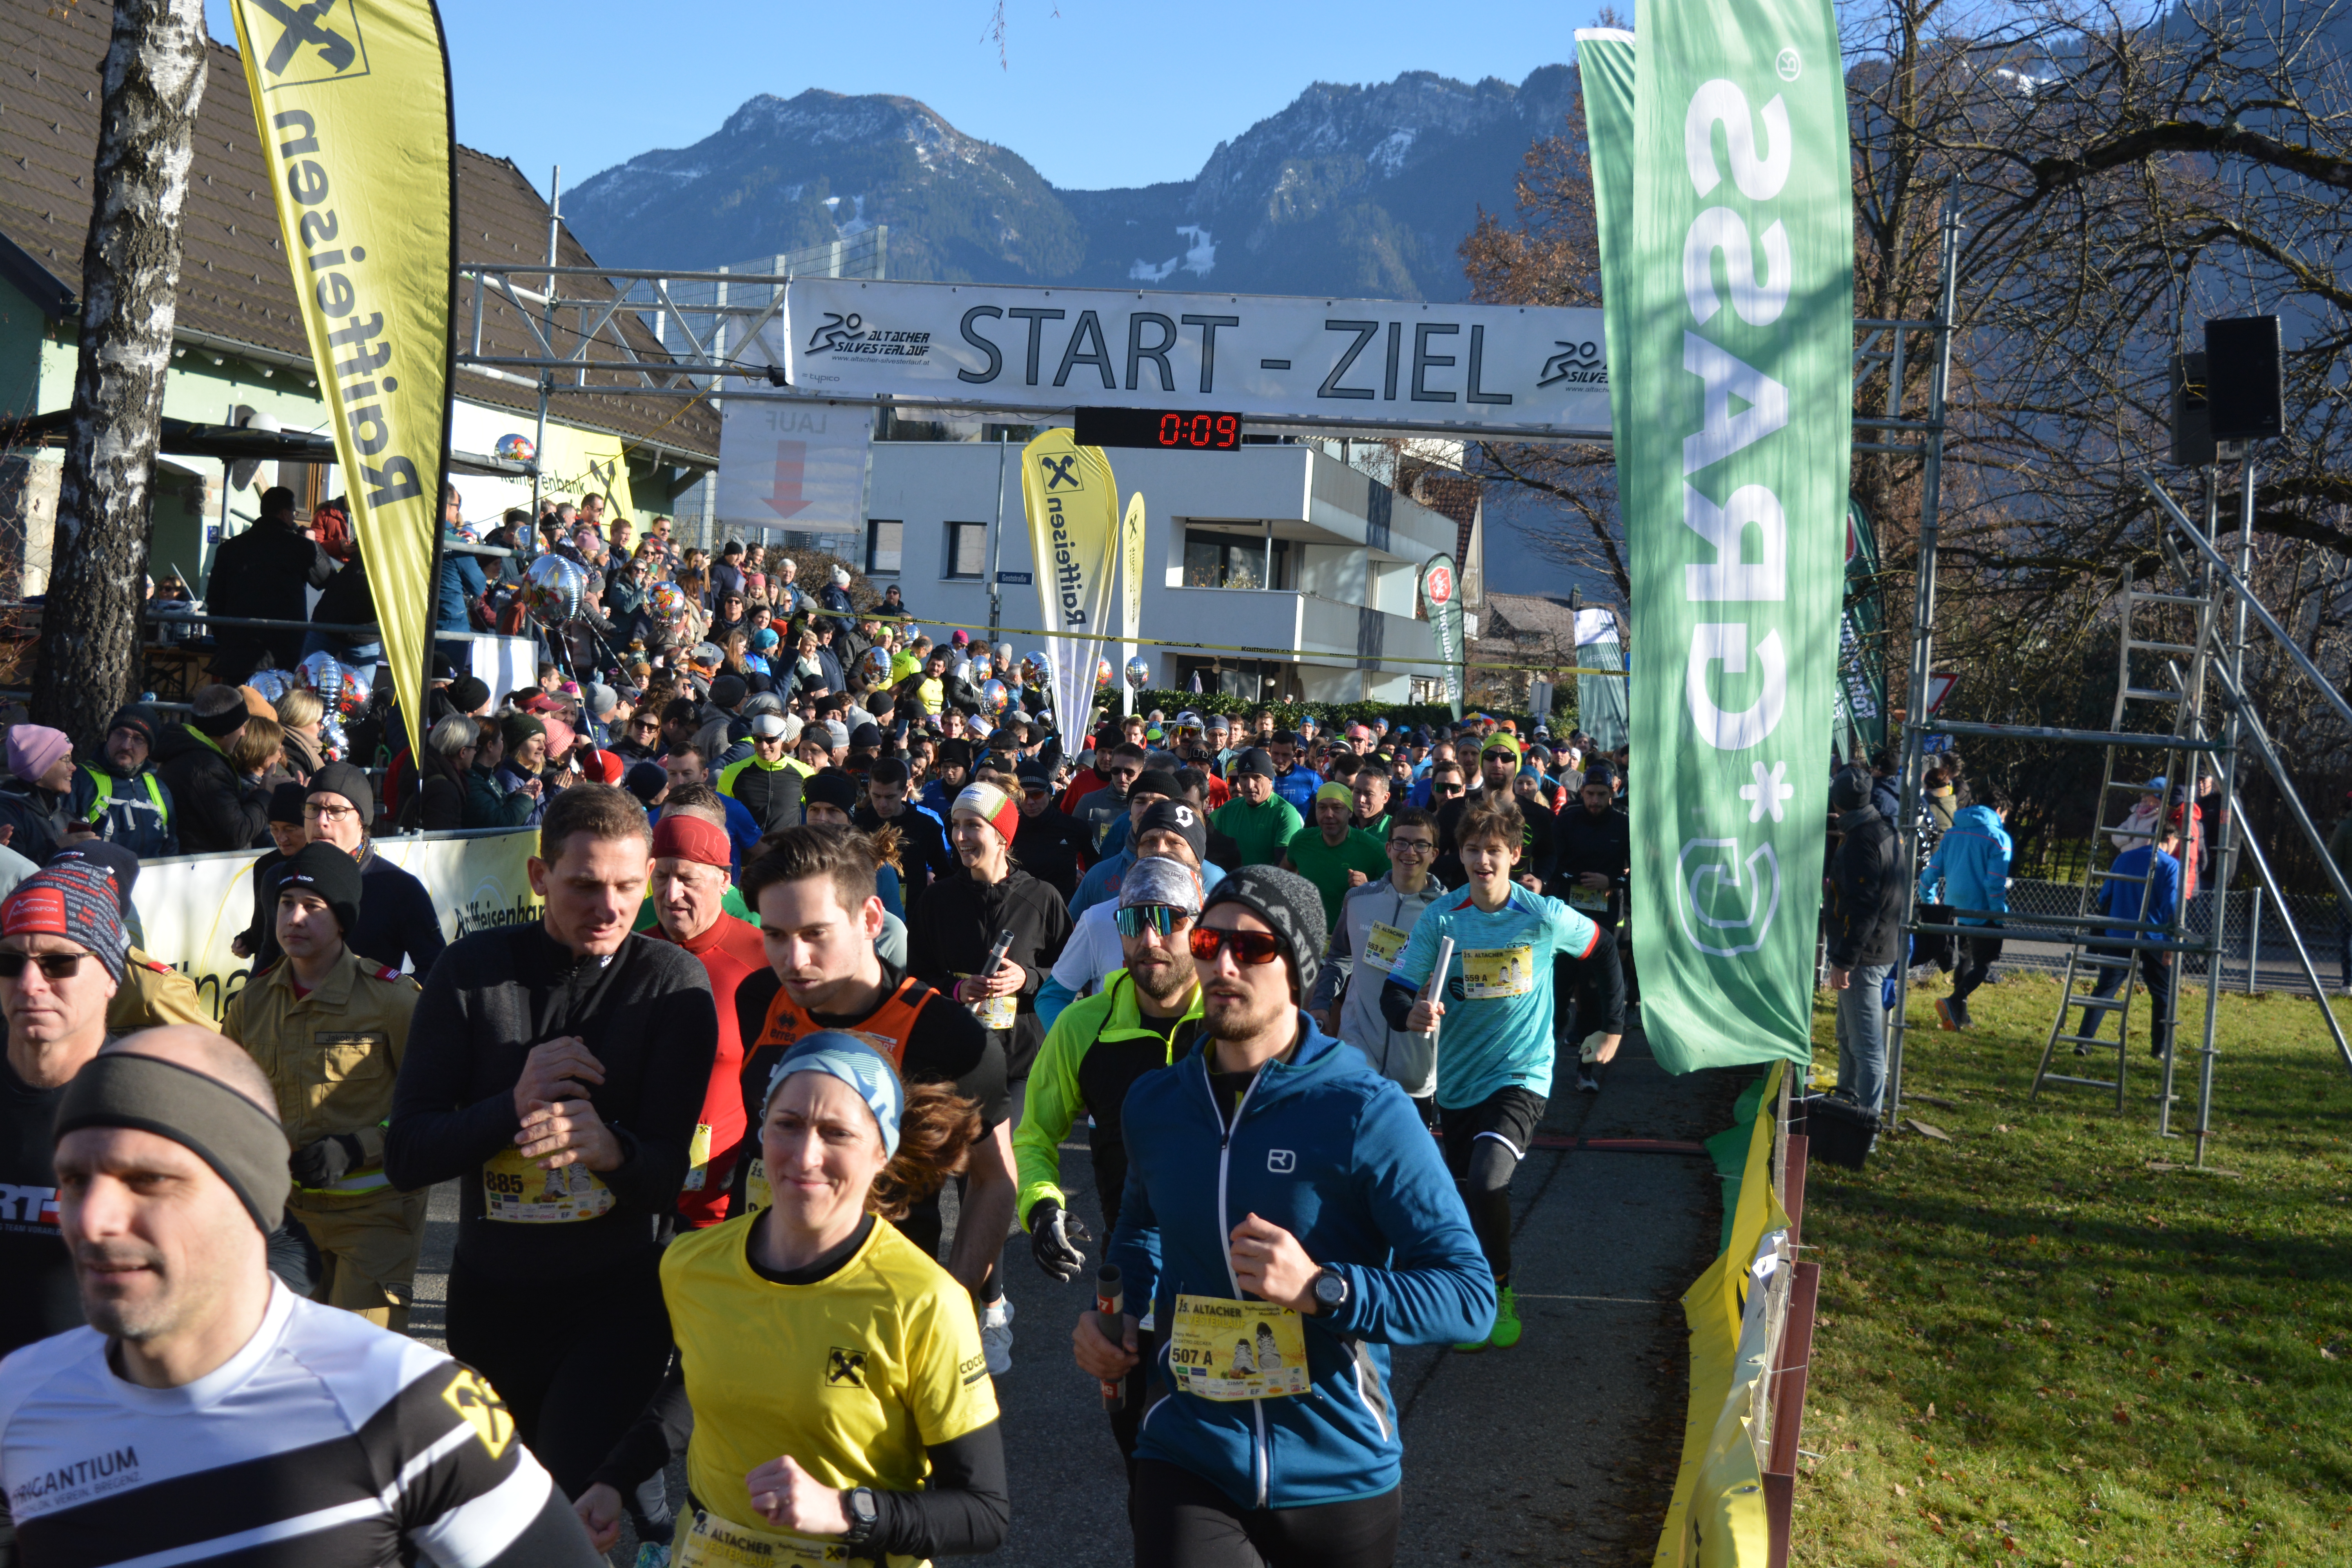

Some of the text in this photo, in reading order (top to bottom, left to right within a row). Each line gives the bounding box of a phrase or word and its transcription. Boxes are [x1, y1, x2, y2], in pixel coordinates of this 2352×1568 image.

[867, 330, 931, 343] ALTACHER
[835, 341, 930, 356] SILVESTERLAUF
[957, 305, 1239, 394] START
[1317, 320, 1512, 405] ZIEL
[832, 355, 930, 365] www.altacher-silvesterlauf.at
[1159, 414, 1236, 447] 0:09
[1002, 574, 1026, 583] Goststraße
[1170, 871, 1183, 882] Buff
[13, 906, 58, 916] MONTAFON
[1382, 927, 1405, 939] ALTACHER
[1367, 942, 1379, 951] 553
[326, 1034, 373, 1042] Jakob Sch.
[750, 1166, 764, 1178] 25.
[486, 1171, 524, 1194] 885
[5, 1224, 26, 1232] TEAM
[1178, 1302, 1242, 1318] 25. ALTACHER
[1176, 1314, 1246, 1329] SILVESTERLAUF
[1172, 1347, 1213, 1365] 507 A
[710, 1528, 771, 1555] ALTACHER
[688, 1532, 775, 1568] SILVESTERLAUF
